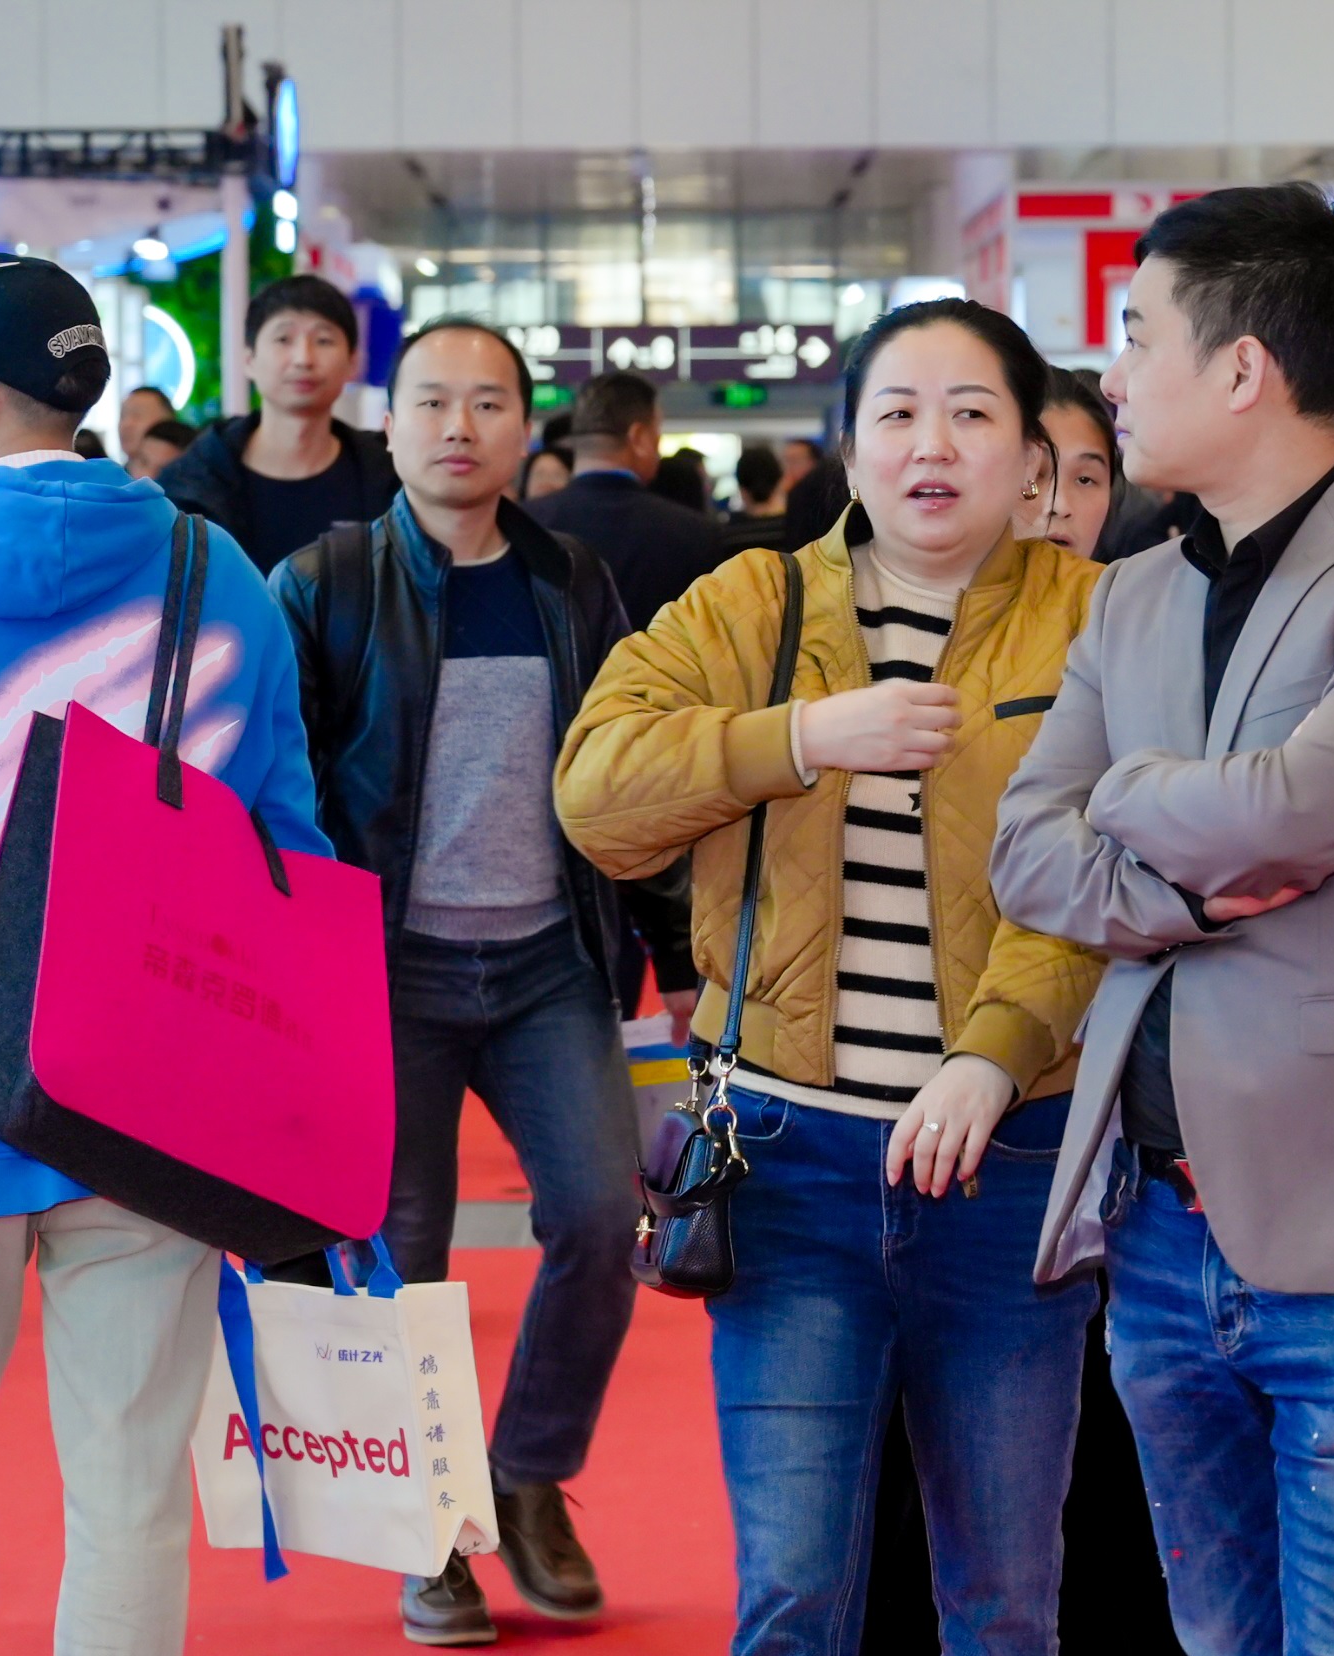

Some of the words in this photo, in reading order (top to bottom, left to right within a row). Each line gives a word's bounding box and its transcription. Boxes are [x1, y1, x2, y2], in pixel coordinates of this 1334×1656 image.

[337, 1349, 383, 1363] 统计之光
[223, 1411, 410, 1479] Accepted
